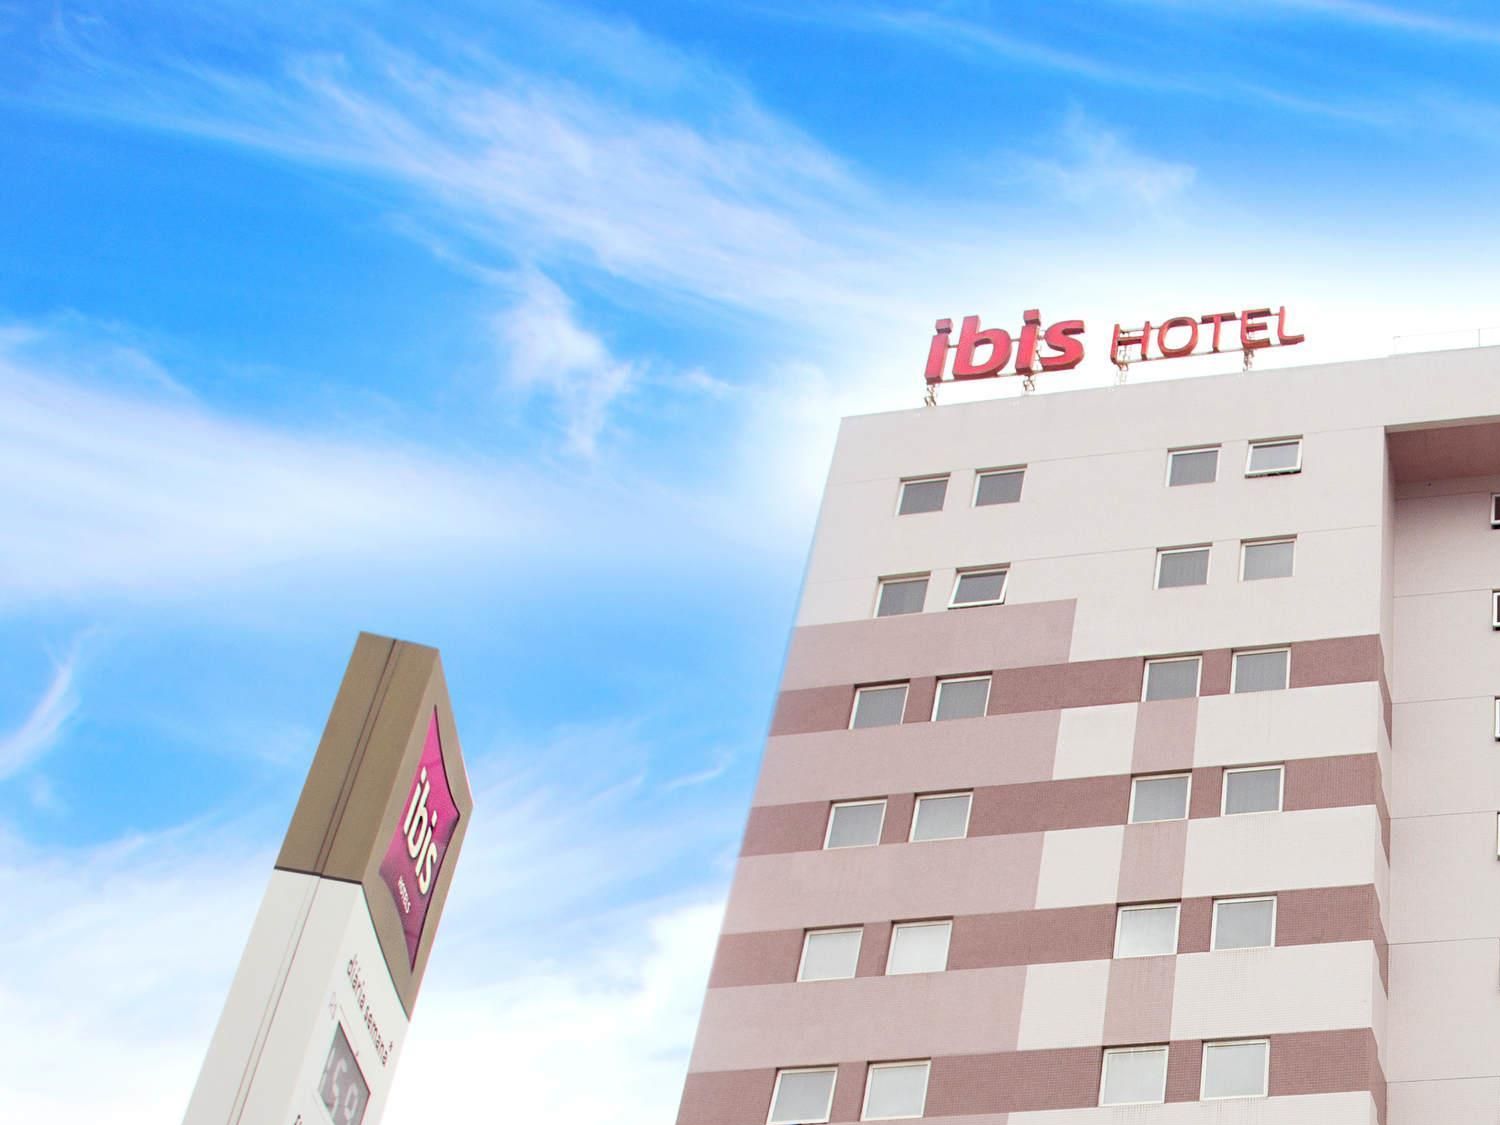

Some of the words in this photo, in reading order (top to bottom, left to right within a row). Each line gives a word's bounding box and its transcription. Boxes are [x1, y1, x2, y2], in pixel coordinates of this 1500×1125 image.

[925, 308, 1086, 384] ibis
[1109, 305, 1305, 363] HOTEL
[403, 765, 438, 895] ibis
